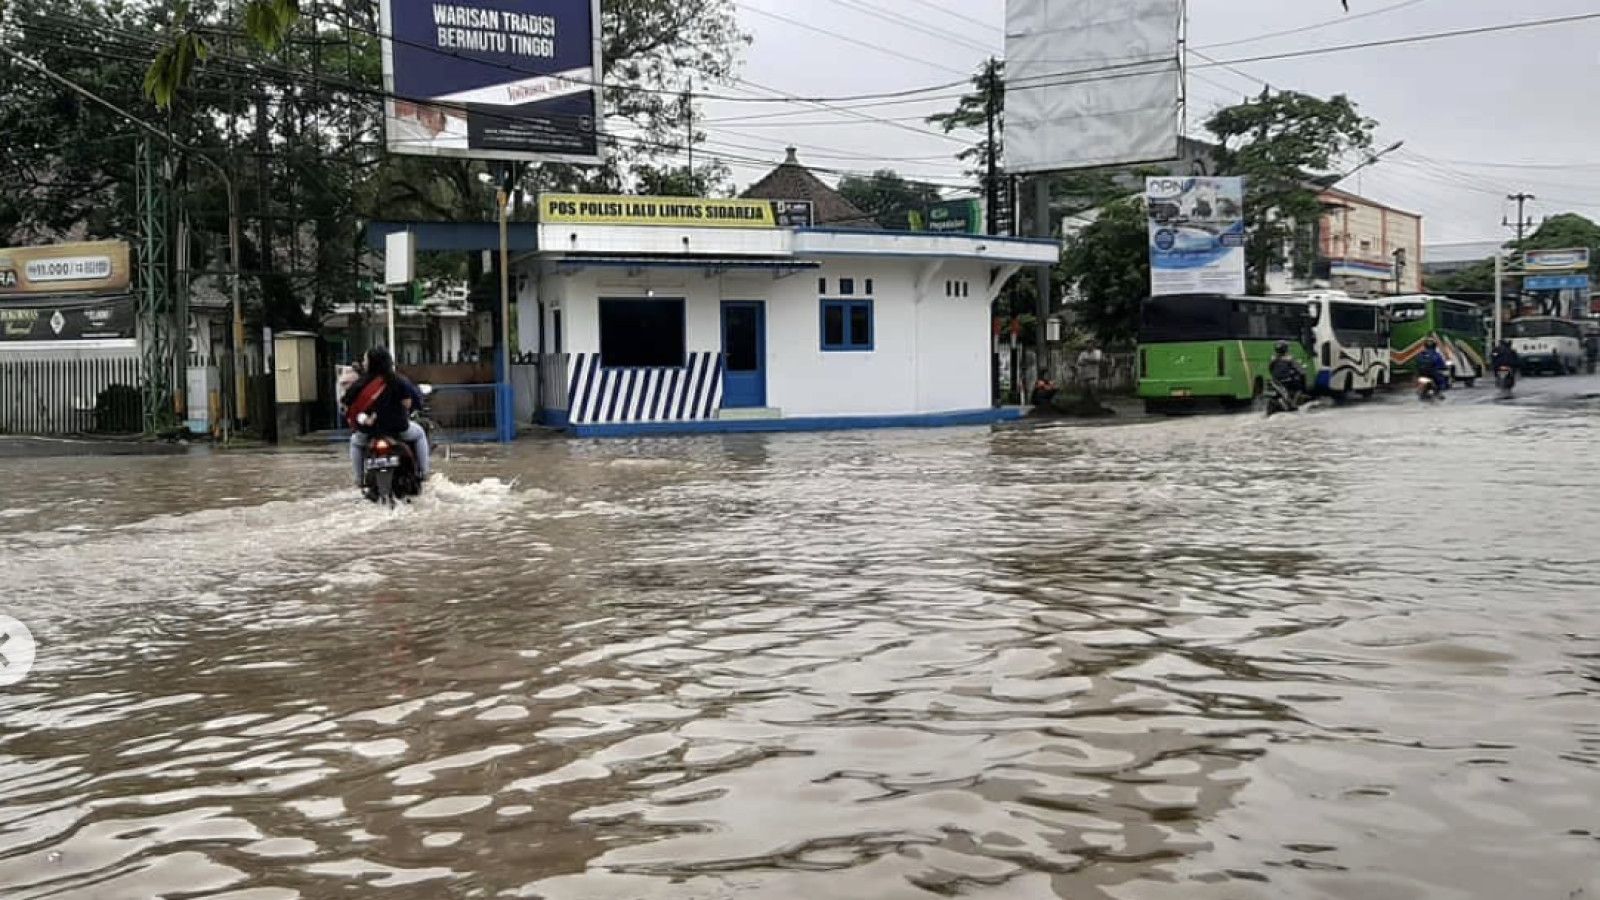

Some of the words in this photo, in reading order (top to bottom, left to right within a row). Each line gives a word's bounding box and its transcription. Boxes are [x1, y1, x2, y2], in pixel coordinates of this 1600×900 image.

[433, 4, 499, 30] WARISAN
[501, 11, 555, 37] TRADISI
[438, 27, 507, 52] BERMUTU
[510, 34, 554, 58] TINGGI
[549, 201, 576, 215] POS
[580, 202, 622, 216] POLISI
[626, 203, 656, 217] LALU
[660, 204, 702, 218] LINTAS
[705, 206, 764, 220] SIDAREJA
